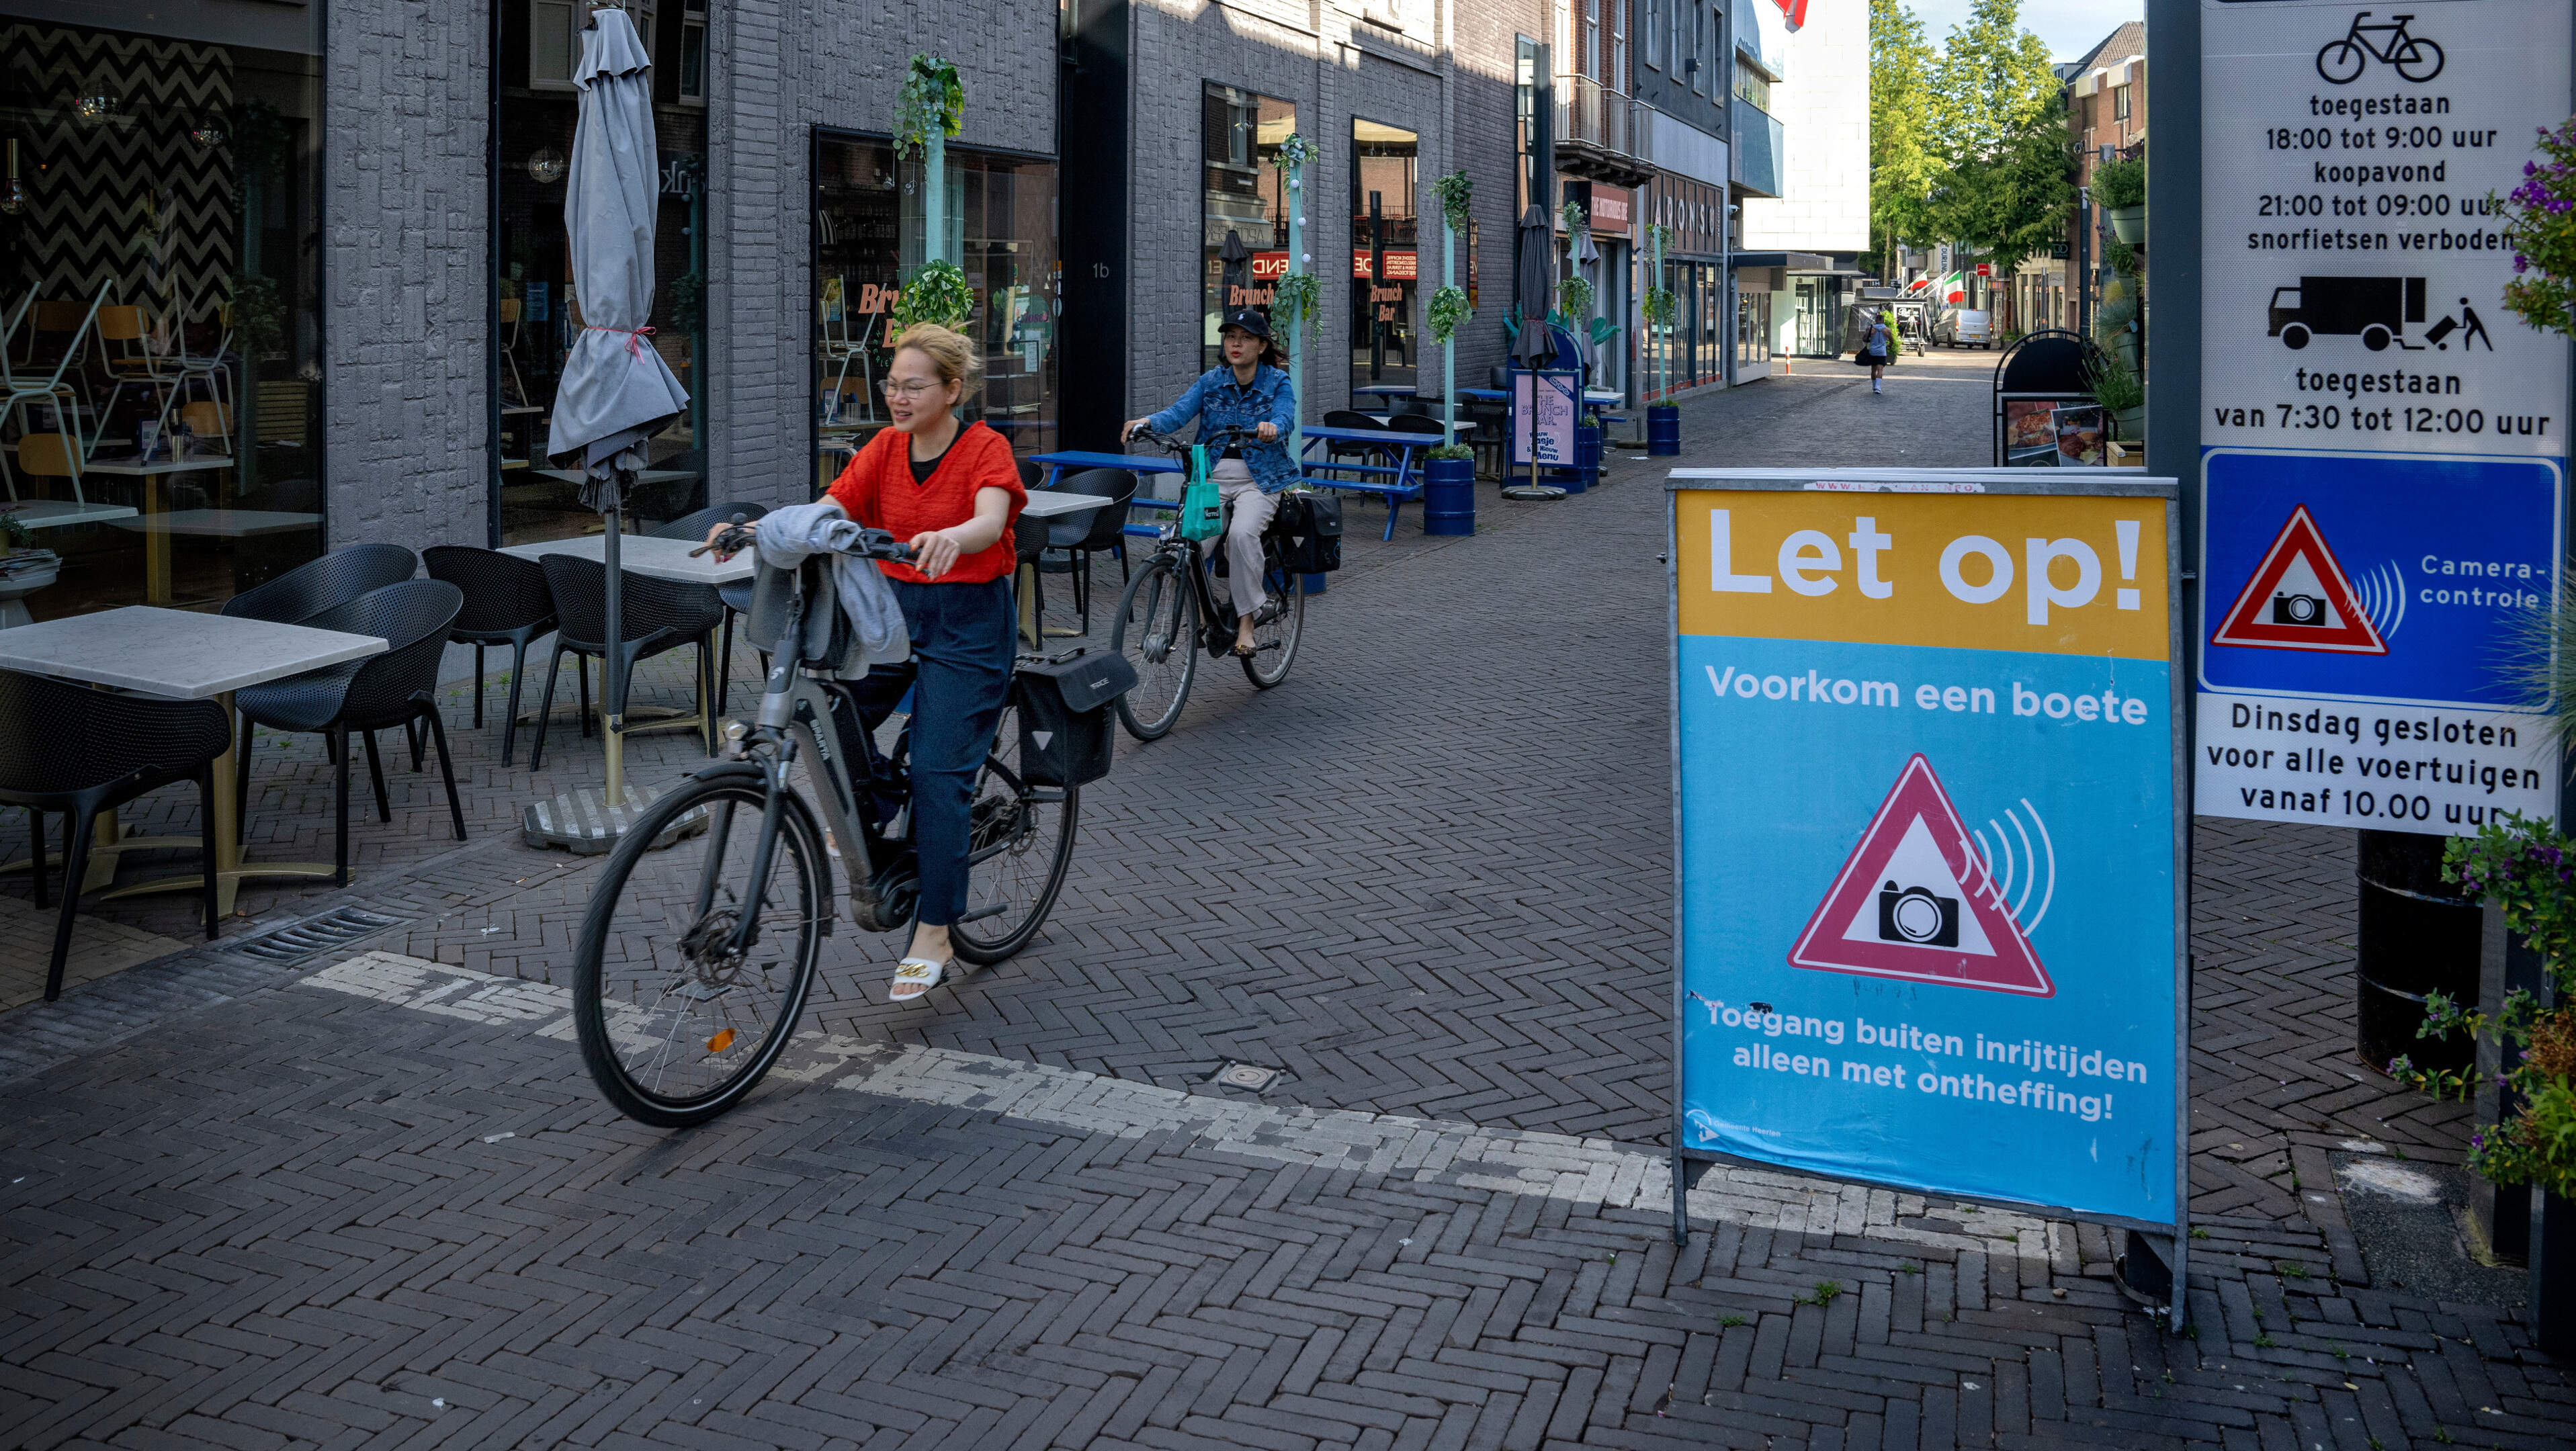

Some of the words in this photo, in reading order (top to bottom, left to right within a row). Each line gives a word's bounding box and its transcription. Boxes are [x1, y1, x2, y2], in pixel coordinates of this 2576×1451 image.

[2311, 94, 2450, 122] toegestaan
[2267, 128, 2331, 149] 18:00
[2340, 128, 2376, 148] tot
[2386, 126, 2442, 148] 9:00
[2453, 130, 2497, 147] uur
[2315, 161, 2445, 186] koopavond
[2259, 195, 2323, 216] 21:00
[2332, 194, 2367, 216] tot
[2377, 194, 2450, 215] 09:00
[2461, 200, 2505, 216] uur
[2248, 228, 2387, 249] snorfietsen
[2399, 228, 2514, 250] verboden
[1093, 263, 1109, 278] 1b
[1229, 283, 1274, 306] Brunch
[1371, 283, 1402, 302] Brunch
[1379, 304, 1396, 322] Bar
[2296, 367, 2460, 399] toegestaan
[2215, 407, 2264, 428] van
[2277, 404, 2339, 429] 7:30
[2352, 406, 2392, 431] tot
[2405, 408, 2483, 434] 12:00
[2497, 413, 2550, 435] uur
[1711, 509, 1893, 599] Let
[1939, 521, 2141, 626] op!
[2421, 555, 2546, 579] Camera-
[2420, 588, 2540, 609] controle
[1705, 665, 1899, 708] Voorkom
[1916, 683, 1995, 714] een
[2013, 682, 2147, 725] boete
[2233, 703, 2360, 744] Dinsdag
[2374, 716, 2516, 748] gesloten
[2206, 746, 2274, 769] voor
[2286, 748, 2344, 775] alle
[2357, 757, 2540, 794] voertuigen
[2241, 787, 2330, 814] vanaf
[2343, 789, 2430, 820] 10.00
[2446, 804, 2501, 825] uur
[1708, 1004, 1844, 1045] Toegang
[1857, 1018, 1963, 1057] buiten
[1976, 1032, 2147, 1084] inrijtijden
[1733, 1043, 1830, 1078] alleen
[1842, 1061, 1906, 1090] met
[1917, 1071, 2114, 1123] ontheffing!
[1714, 1120, 1750, 1132] Gemeente
[1752, 1127, 1780, 1137] Heerlen
